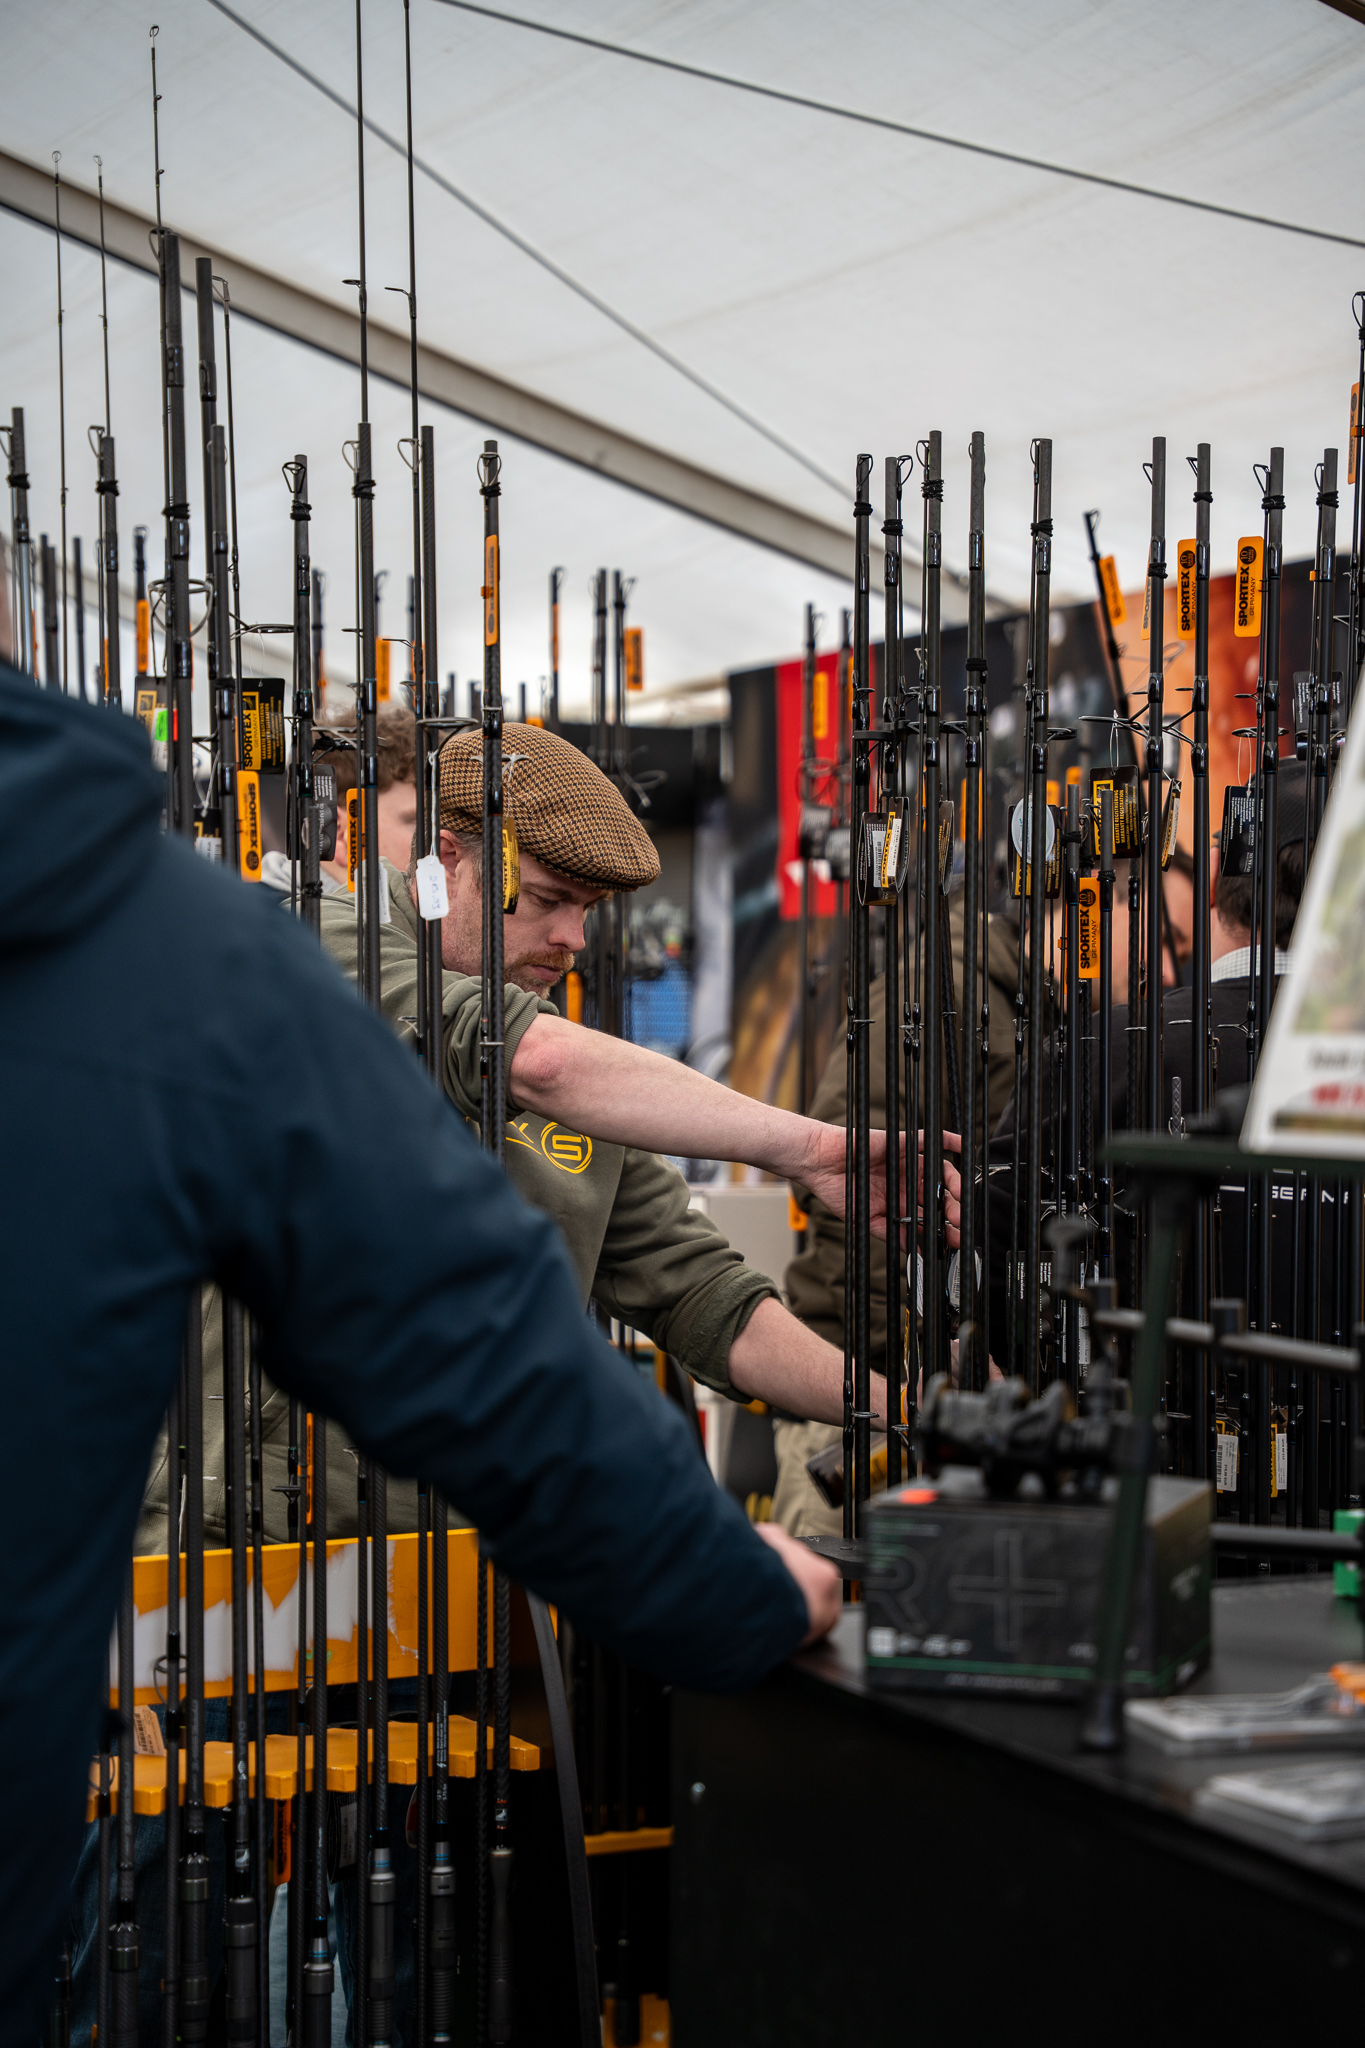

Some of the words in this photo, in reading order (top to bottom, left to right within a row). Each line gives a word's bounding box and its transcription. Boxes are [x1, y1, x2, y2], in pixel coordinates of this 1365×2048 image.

[1181, 570, 1190, 631] SPORTEX
[1238, 566, 1250, 626] SPORTEX
[243, 712, 253, 768] SPORTEX
[248, 782, 258, 849] SPORTEX
[1080, 908, 1090, 969] SPORTEX
